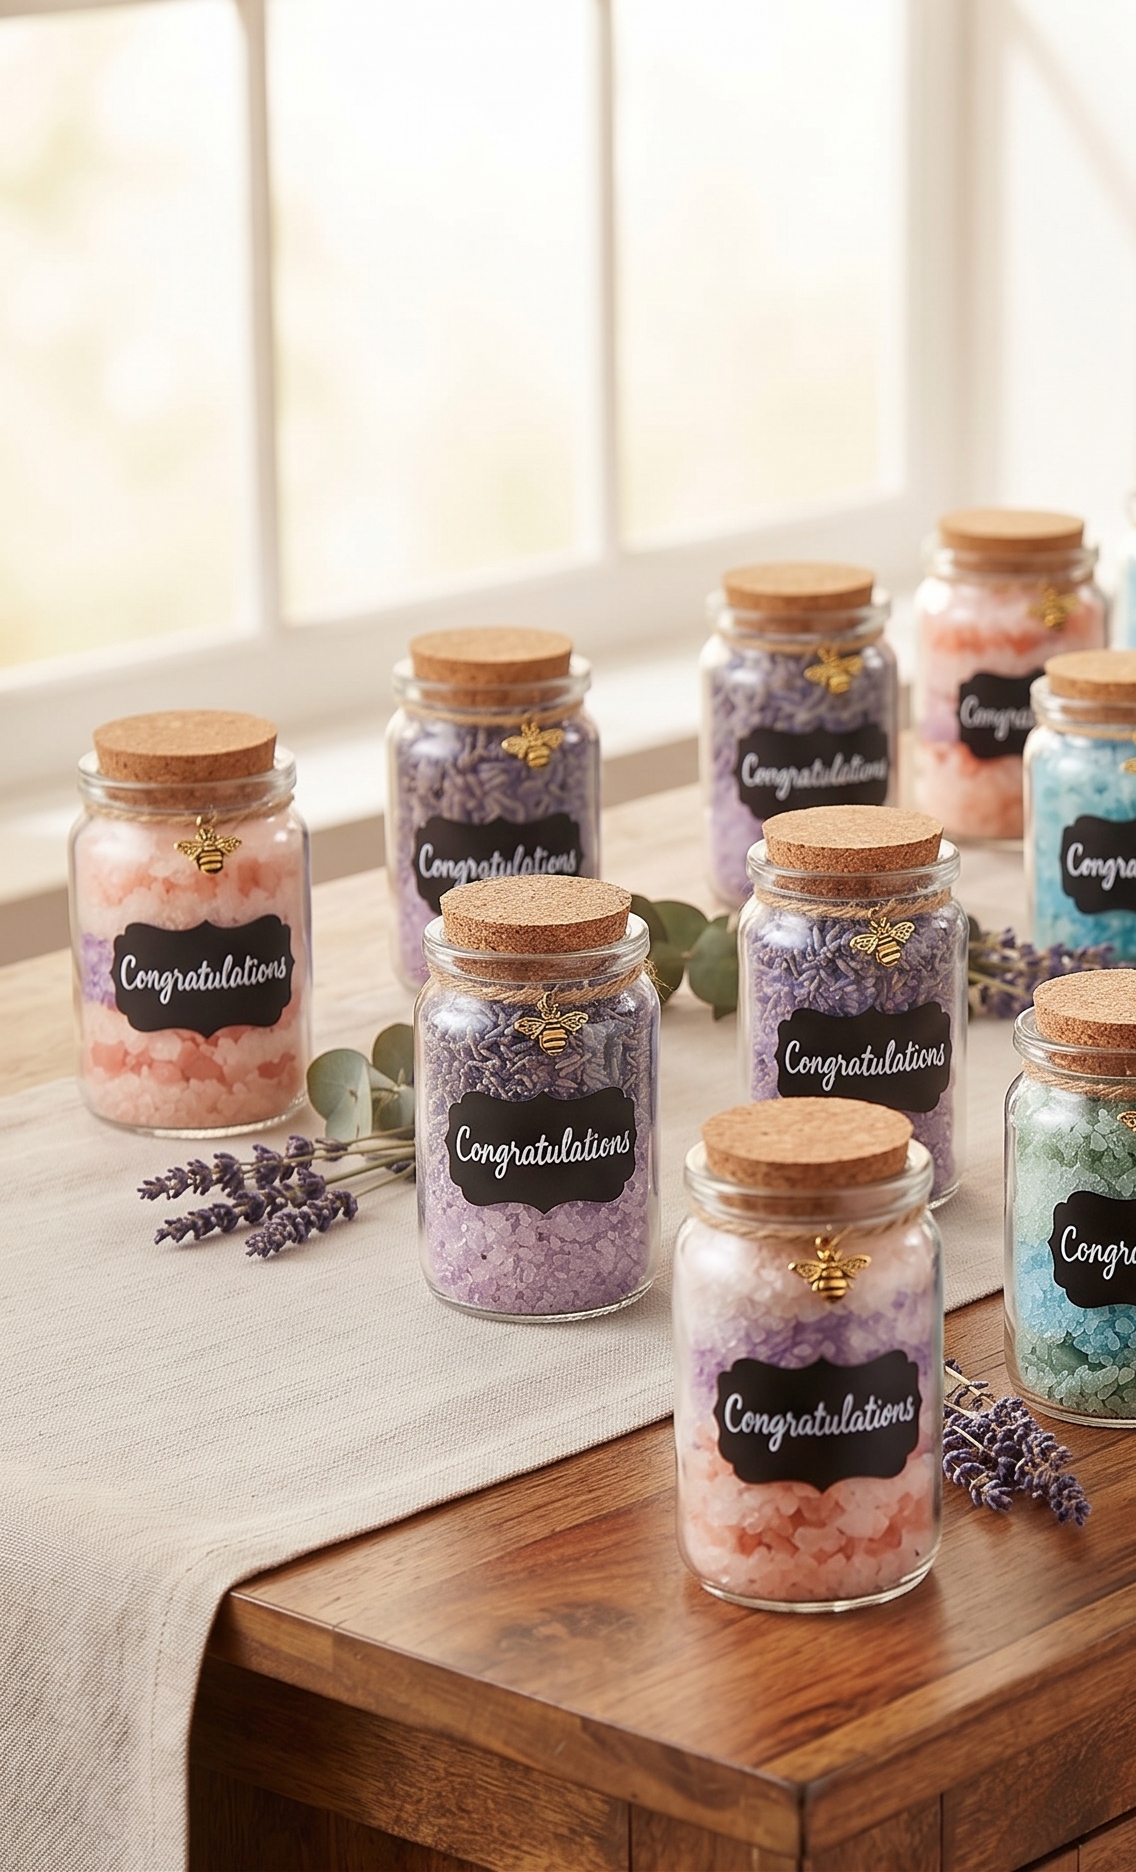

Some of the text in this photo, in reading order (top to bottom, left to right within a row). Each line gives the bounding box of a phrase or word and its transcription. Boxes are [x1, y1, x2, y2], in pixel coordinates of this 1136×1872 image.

[741, 752, 888, 801] Congratulations
[418, 842, 577, 886] Congratulations
[120, 954, 287, 1005] Congratulations
[785, 1039, 945, 1092] Congratulations
[456, 1125, 631, 1180] Congratulations
[724, 1393, 915, 1453] Congratulations
